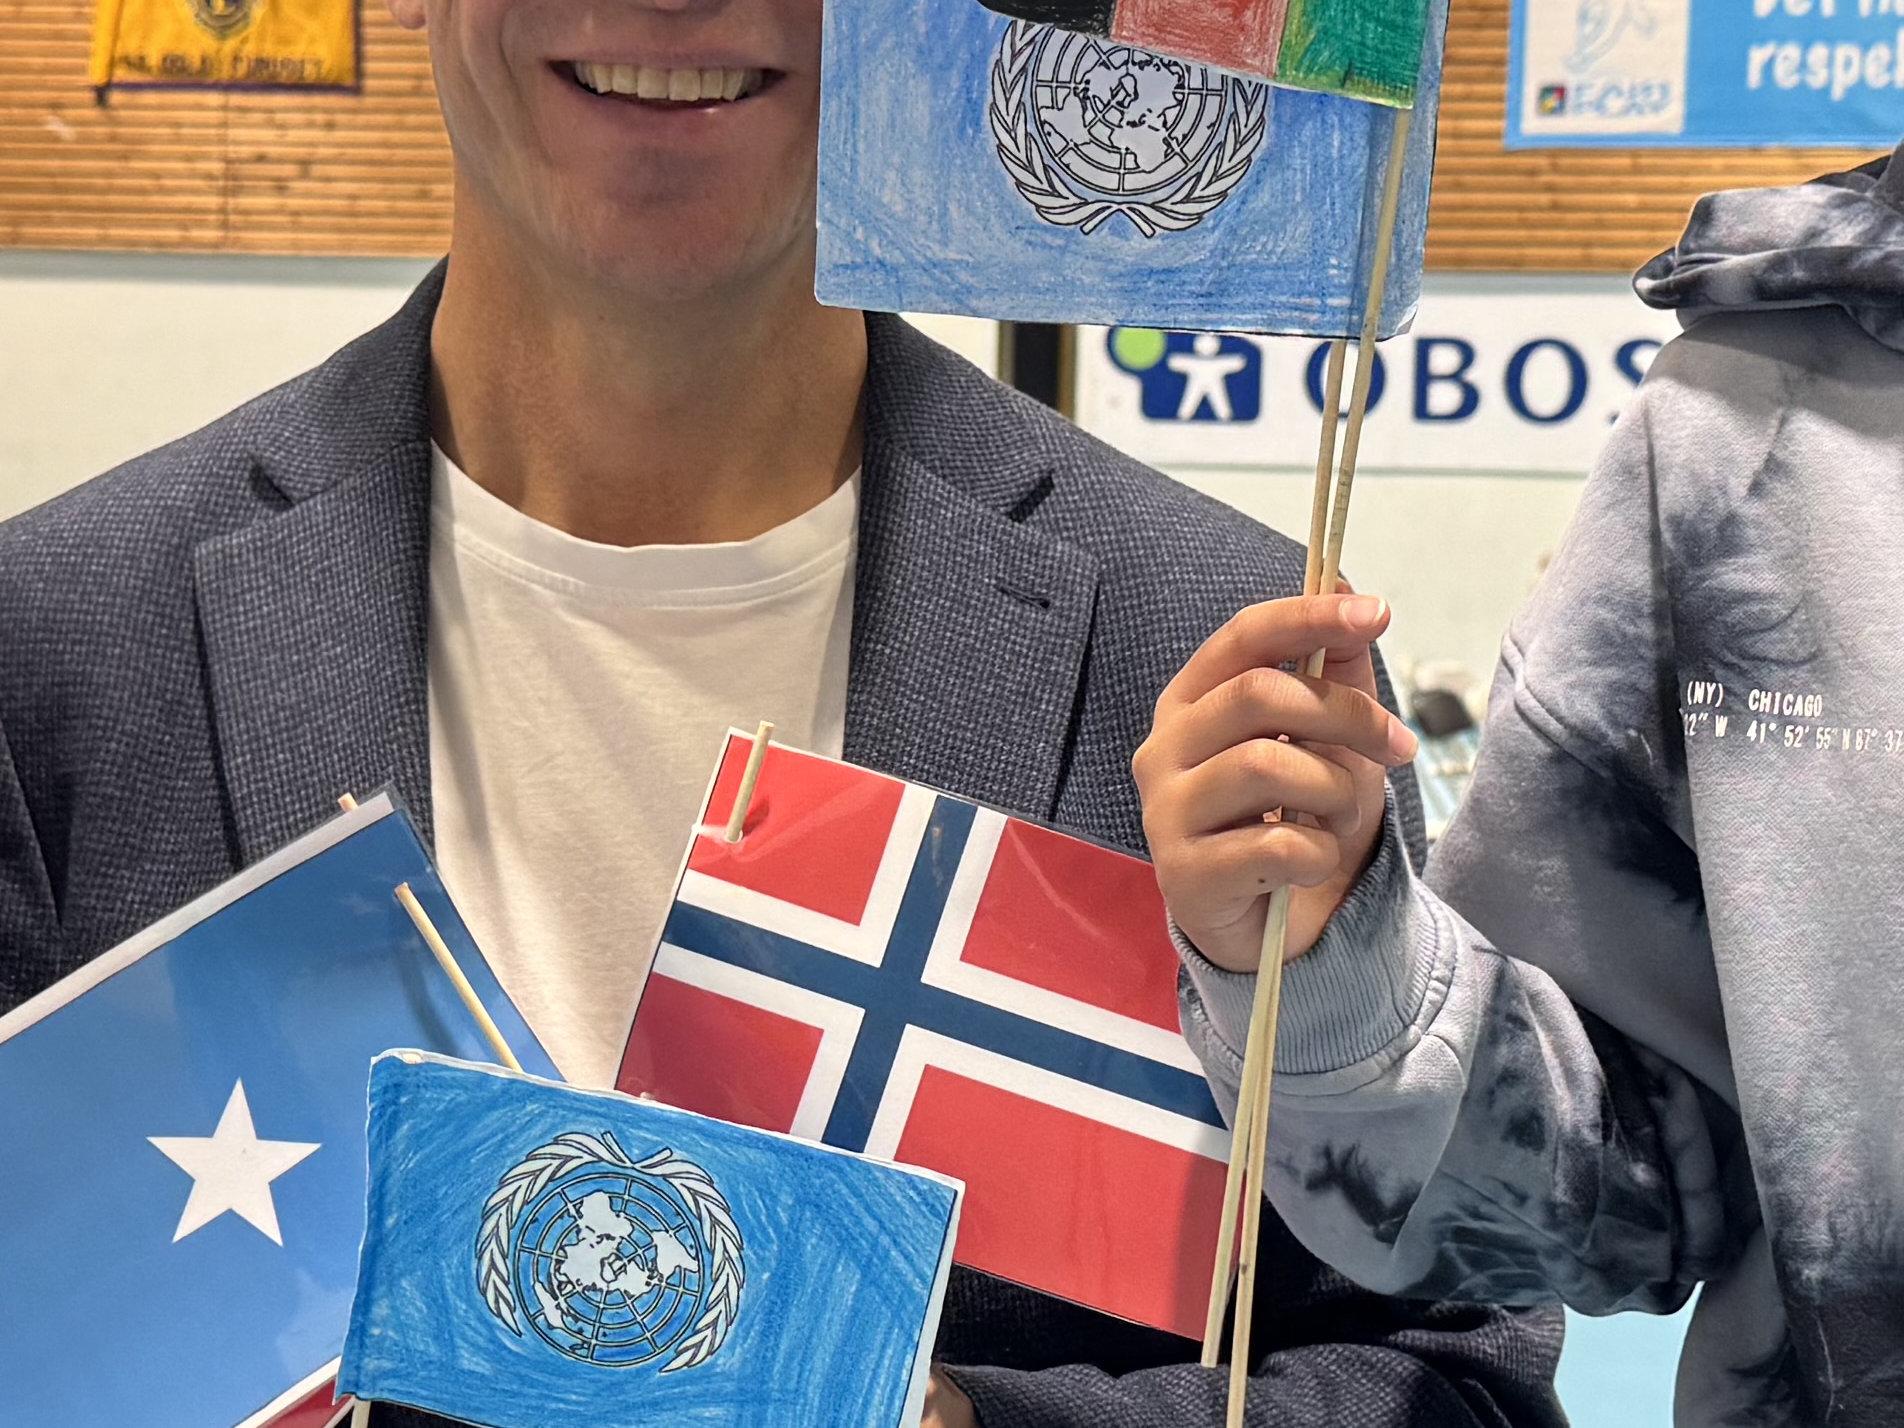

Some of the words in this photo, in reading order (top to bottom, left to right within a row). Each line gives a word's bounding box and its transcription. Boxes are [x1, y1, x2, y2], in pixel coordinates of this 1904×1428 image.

[1687, 681, 1724, 707] (NY)
[1748, 689, 1823, 717] CHICAGO
[1715, 714, 1728, 737] W
